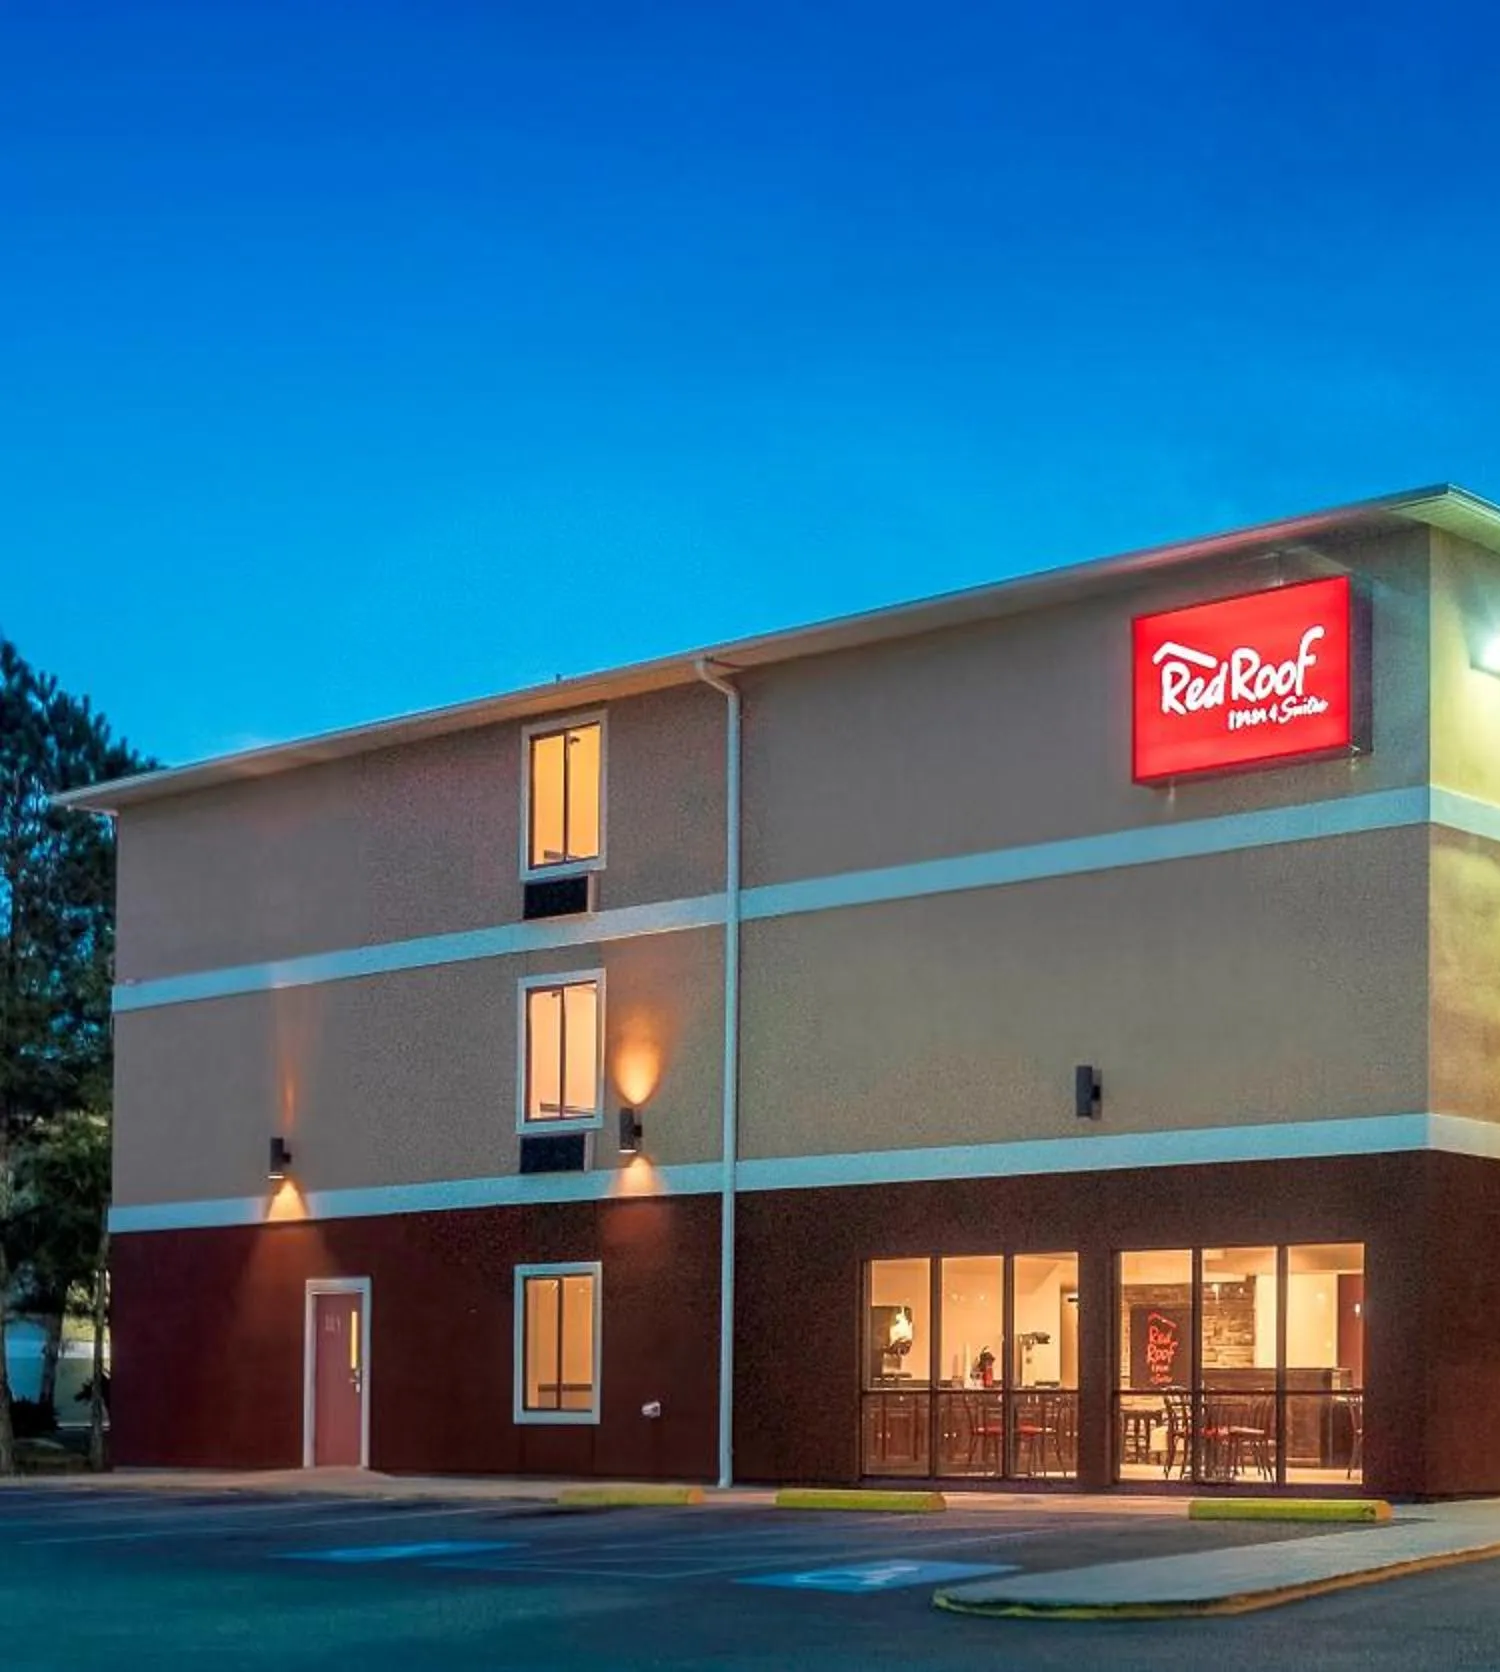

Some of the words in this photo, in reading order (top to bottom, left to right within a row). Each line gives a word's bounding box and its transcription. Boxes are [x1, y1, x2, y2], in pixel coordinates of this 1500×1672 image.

[1161, 661, 1229, 714] Red
[1231, 625, 1325, 702] Roof
[1149, 1326, 1172, 1344] Red
[1146, 1342, 1178, 1364] Roof
